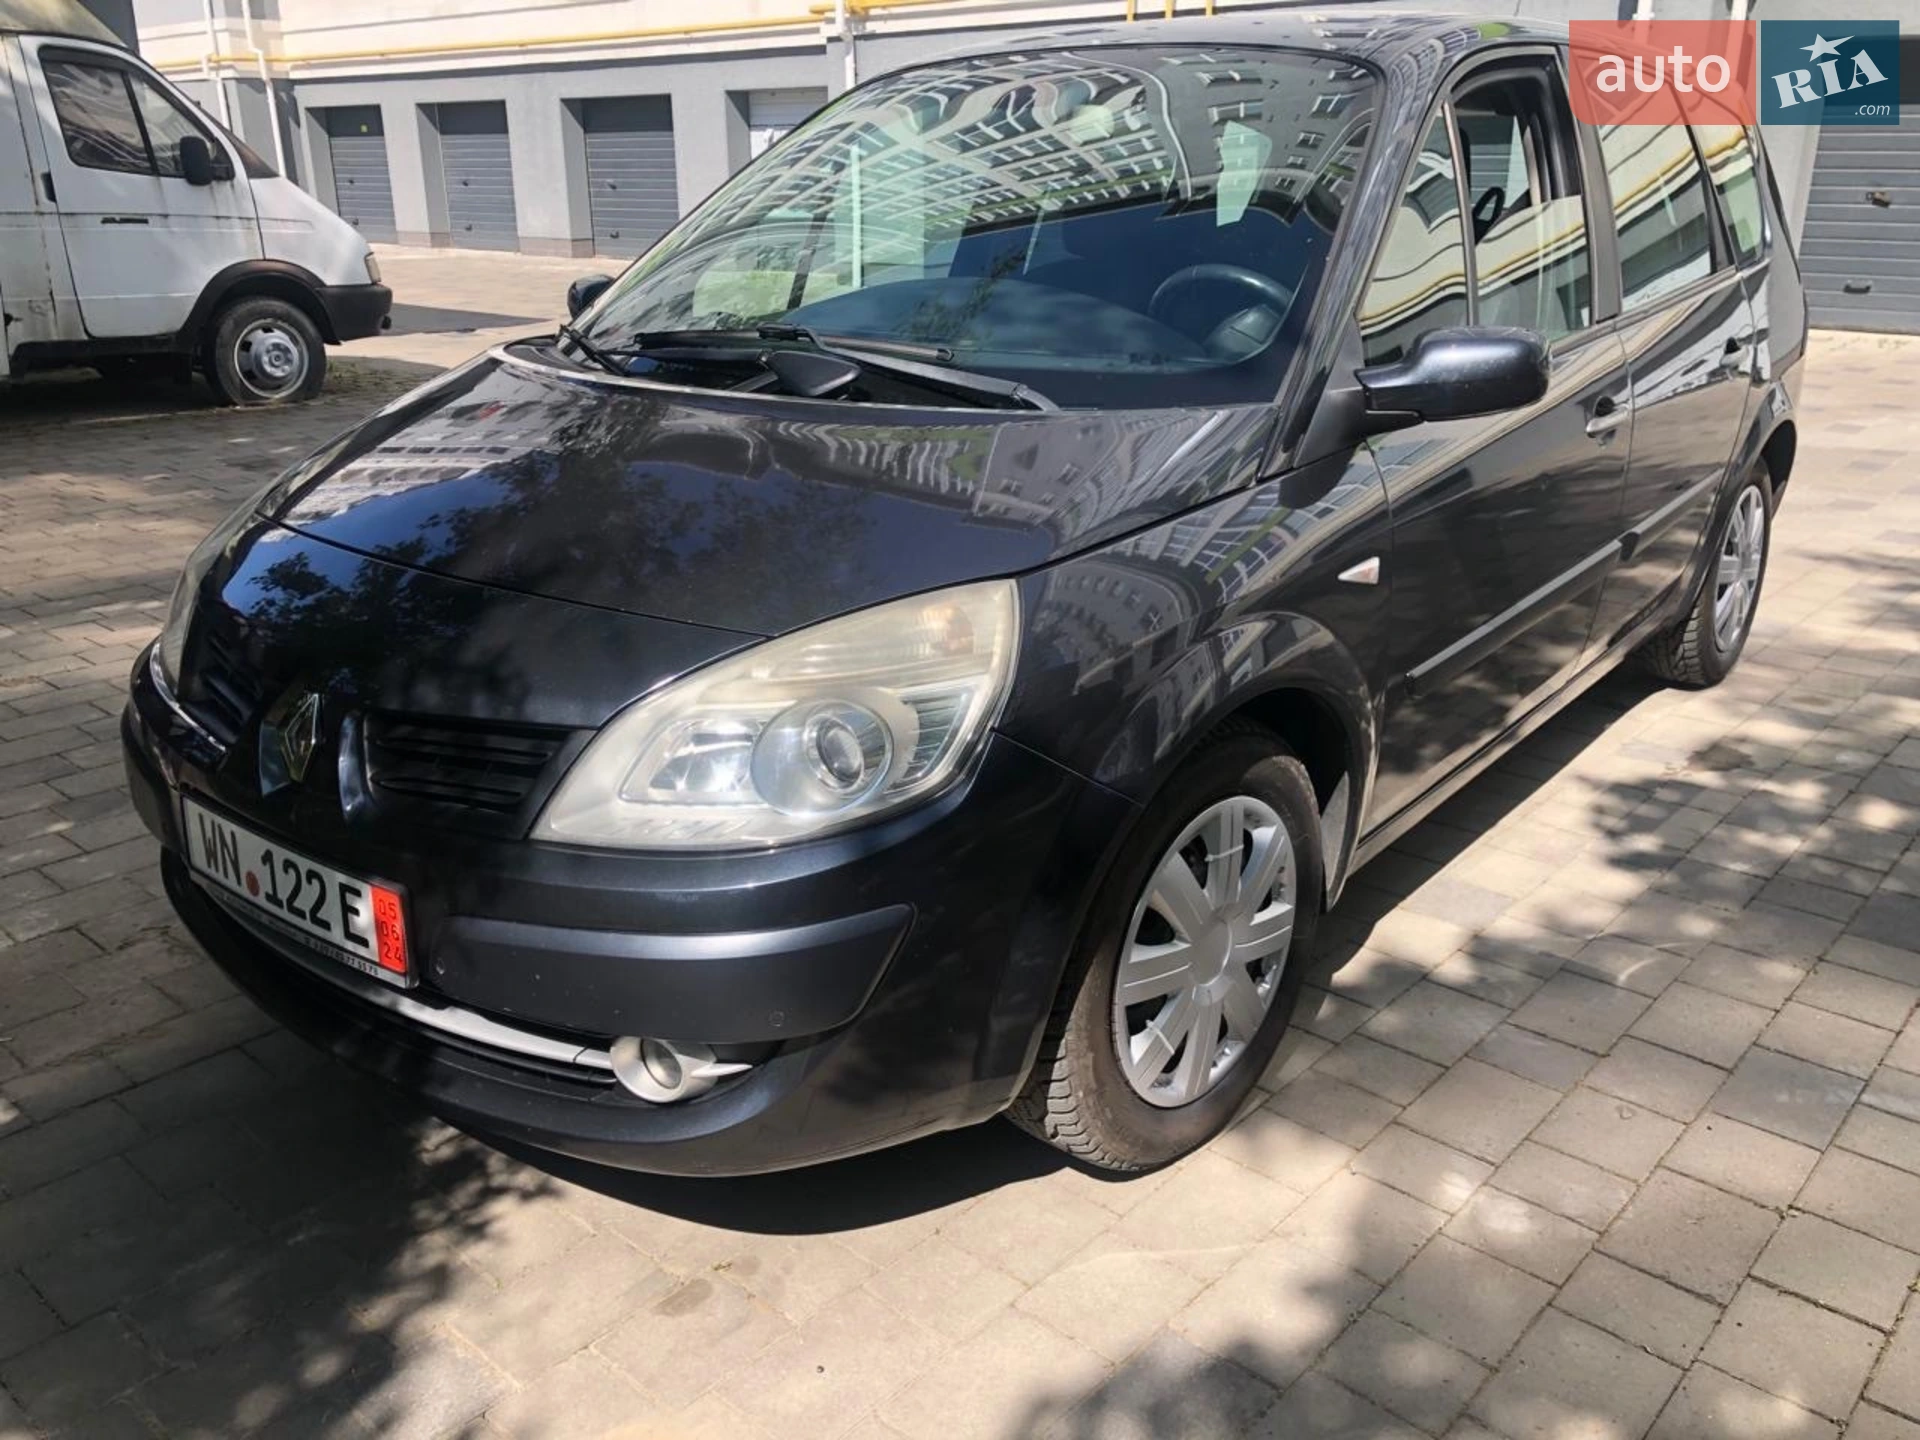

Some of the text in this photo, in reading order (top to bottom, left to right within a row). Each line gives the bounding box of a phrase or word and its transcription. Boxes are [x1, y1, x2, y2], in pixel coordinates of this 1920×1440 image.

[199, 812, 242, 887] WN
[261, 849, 331, 932] 122
[338, 881, 370, 948] E
